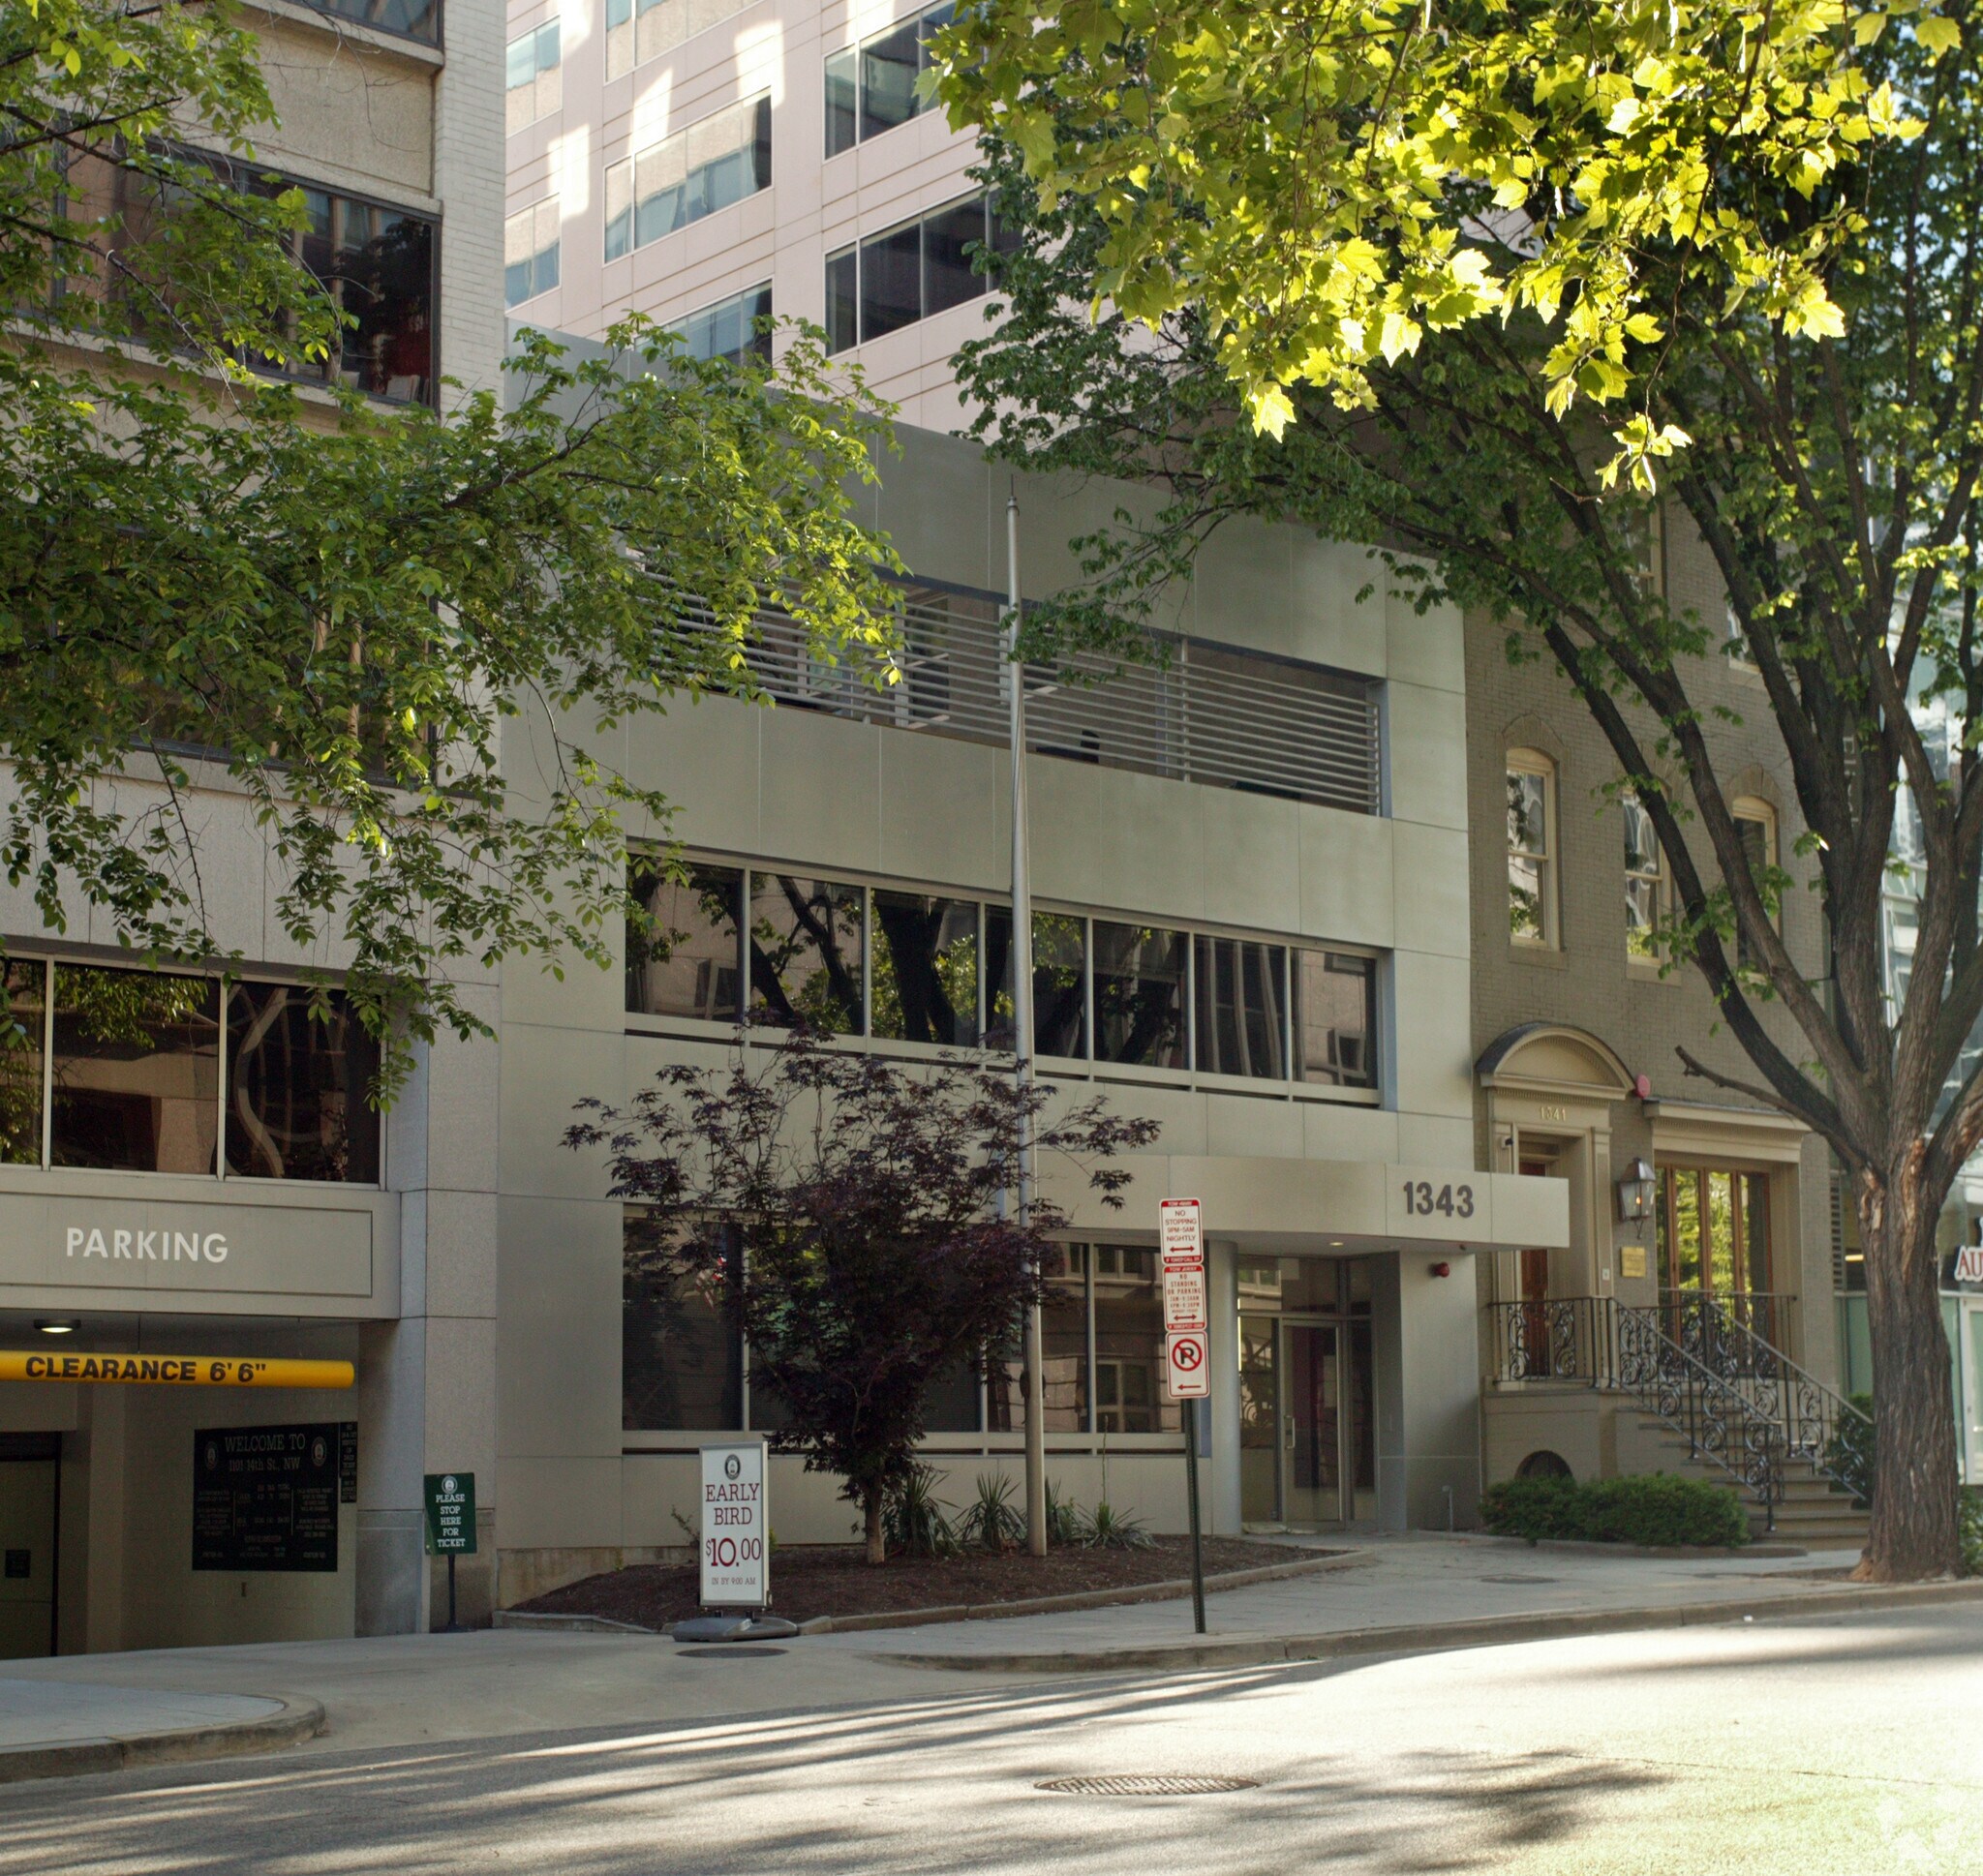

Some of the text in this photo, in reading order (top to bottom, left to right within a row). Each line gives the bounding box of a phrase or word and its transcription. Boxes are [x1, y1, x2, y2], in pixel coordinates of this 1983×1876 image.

[1540, 1106, 1566, 1121] 1341
[1403, 1181, 1475, 1219] 1343
[66, 1227, 229, 1263] PARKING
[25, 1356, 198, 1382] CLEARANCE
[224, 1433, 306, 1453] WELCOME TO
[247, 1458, 264, 1471] 14th
[284, 1456, 301, 1470] NW
[435, 1494, 465, 1502] PLEASE
[705, 1483, 760, 1502] EARLY
[440, 1505, 461, 1515] STOP
[714, 1507, 752, 1526] BIRD
[440, 1517, 462, 1526] HERE
[442, 1528, 459, 1536] FOR
[437, 1538, 466, 1548] TICKET
[705, 1537, 762, 1567] $10.00
[712, 1577, 718, 1586] IN
[720, 1577, 729, 1586] BY
[745, 1577, 756, 1586] AM
